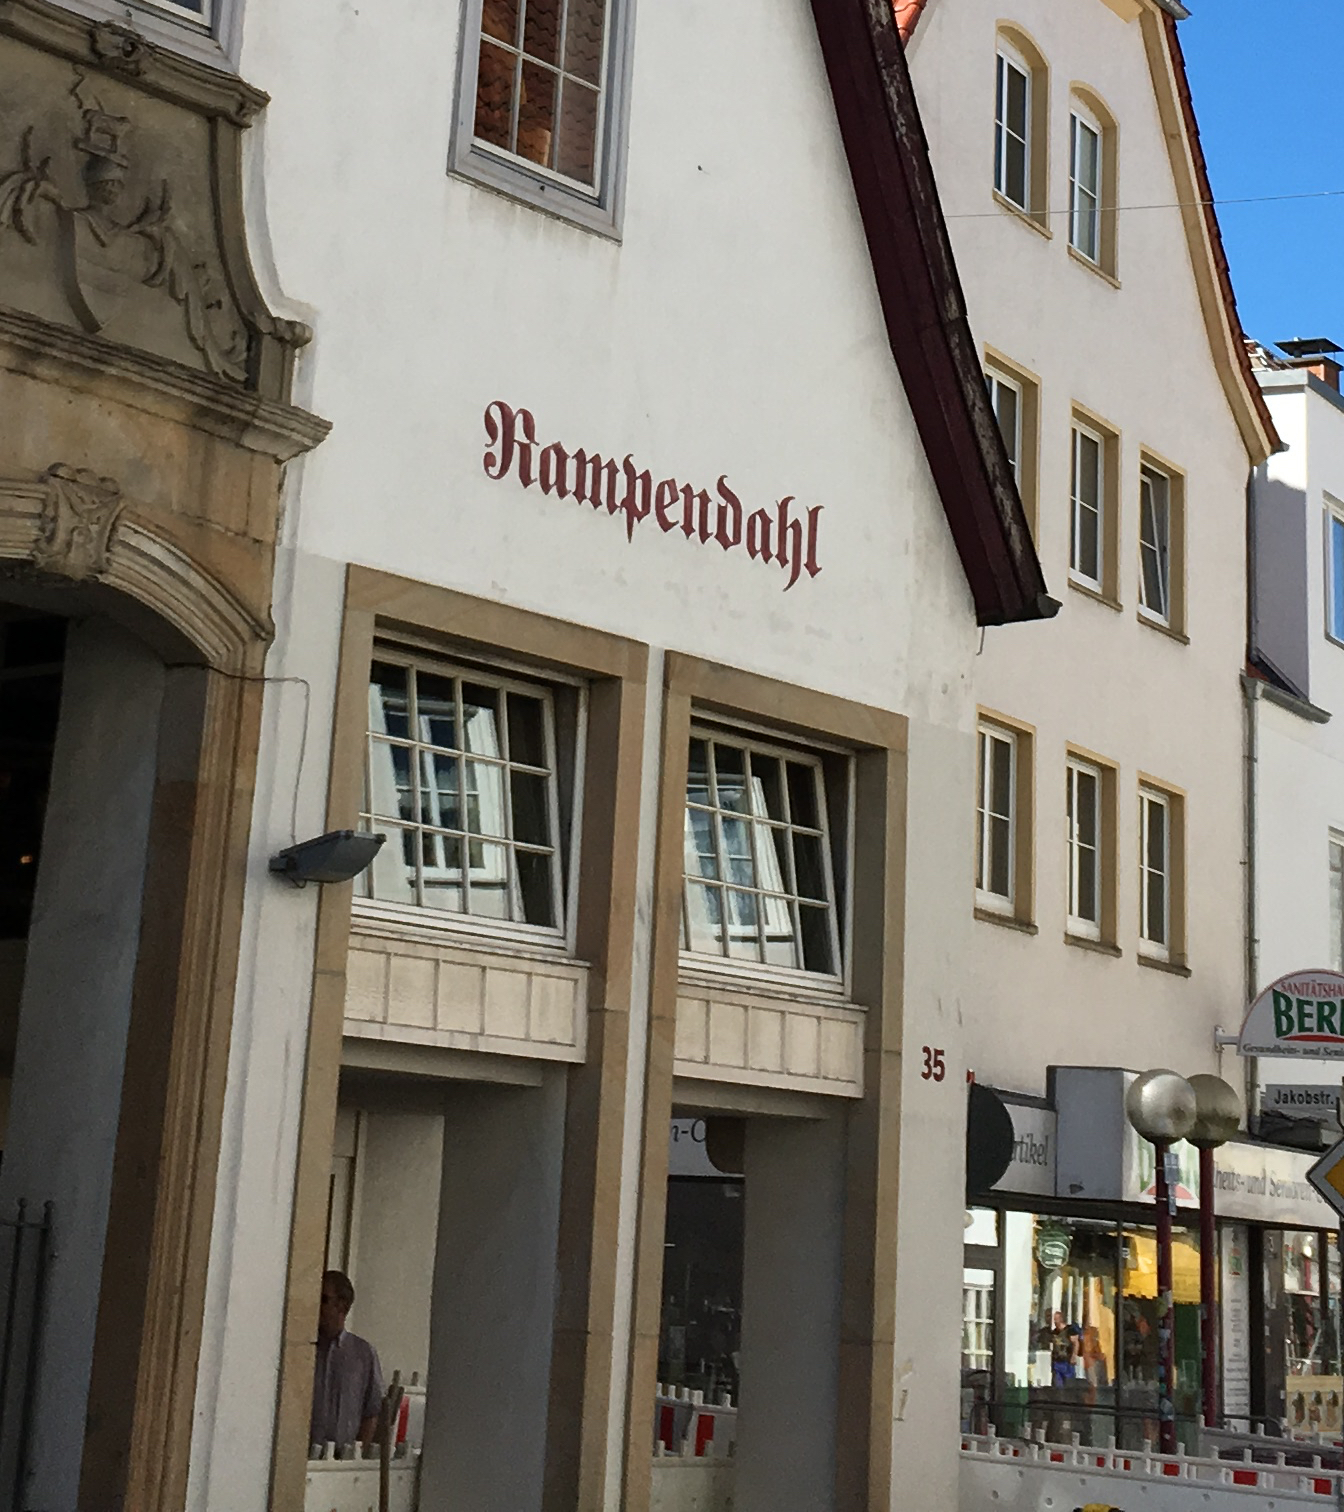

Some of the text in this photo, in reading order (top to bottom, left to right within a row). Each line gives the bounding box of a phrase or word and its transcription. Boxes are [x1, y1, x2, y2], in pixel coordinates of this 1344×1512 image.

[483, 400, 825, 592] Rampendahl
[921, 1045, 946, 1082] 35
[1273, 1090, 1335, 1106] Jakobstr.
[1012, 1134, 1048, 1166] rtikel
